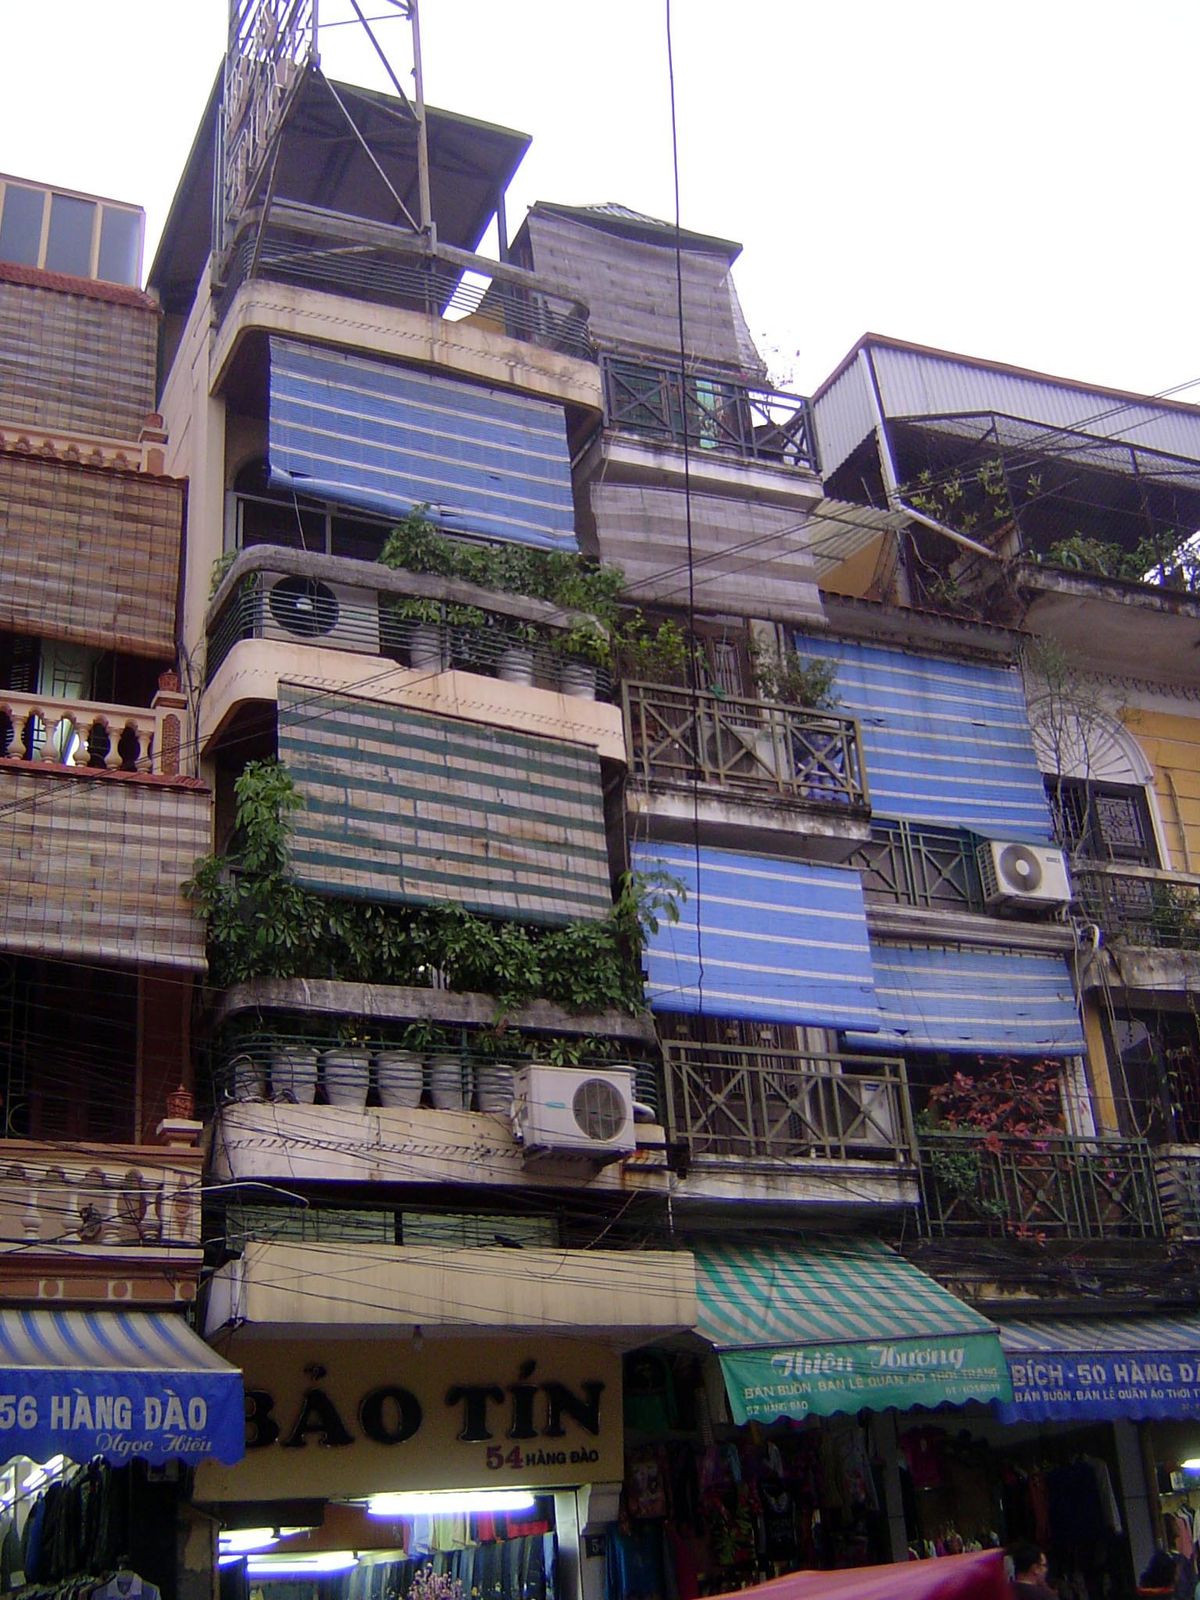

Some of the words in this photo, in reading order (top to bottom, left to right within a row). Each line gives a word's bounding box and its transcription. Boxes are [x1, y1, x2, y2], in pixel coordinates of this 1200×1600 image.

[771, 1351, 853, 1377] Thiên
[1011, 1359, 1063, 1387] BÍCH
[1077, 1364, 1106, 1385] 50
[1114, 1360, 1173, 1384] HÀNG
[243, 1363, 423, 1448] BẢO
[444, 1358, 605, 1443] TÍN
[1014, 1387, 1041, 1402] BÁN
[1076, 1387, 1100, 1401] BÁN
[0, 1394, 39, 1430] 56
[51, 1387, 132, 1430] HÀNG
[143, 1388, 208, 1431] ĐÀO
[486, 1445, 524, 1470] 54
[525, 1448, 567, 1466] HÀNG
[569, 1447, 599, 1464] ĐÀO
